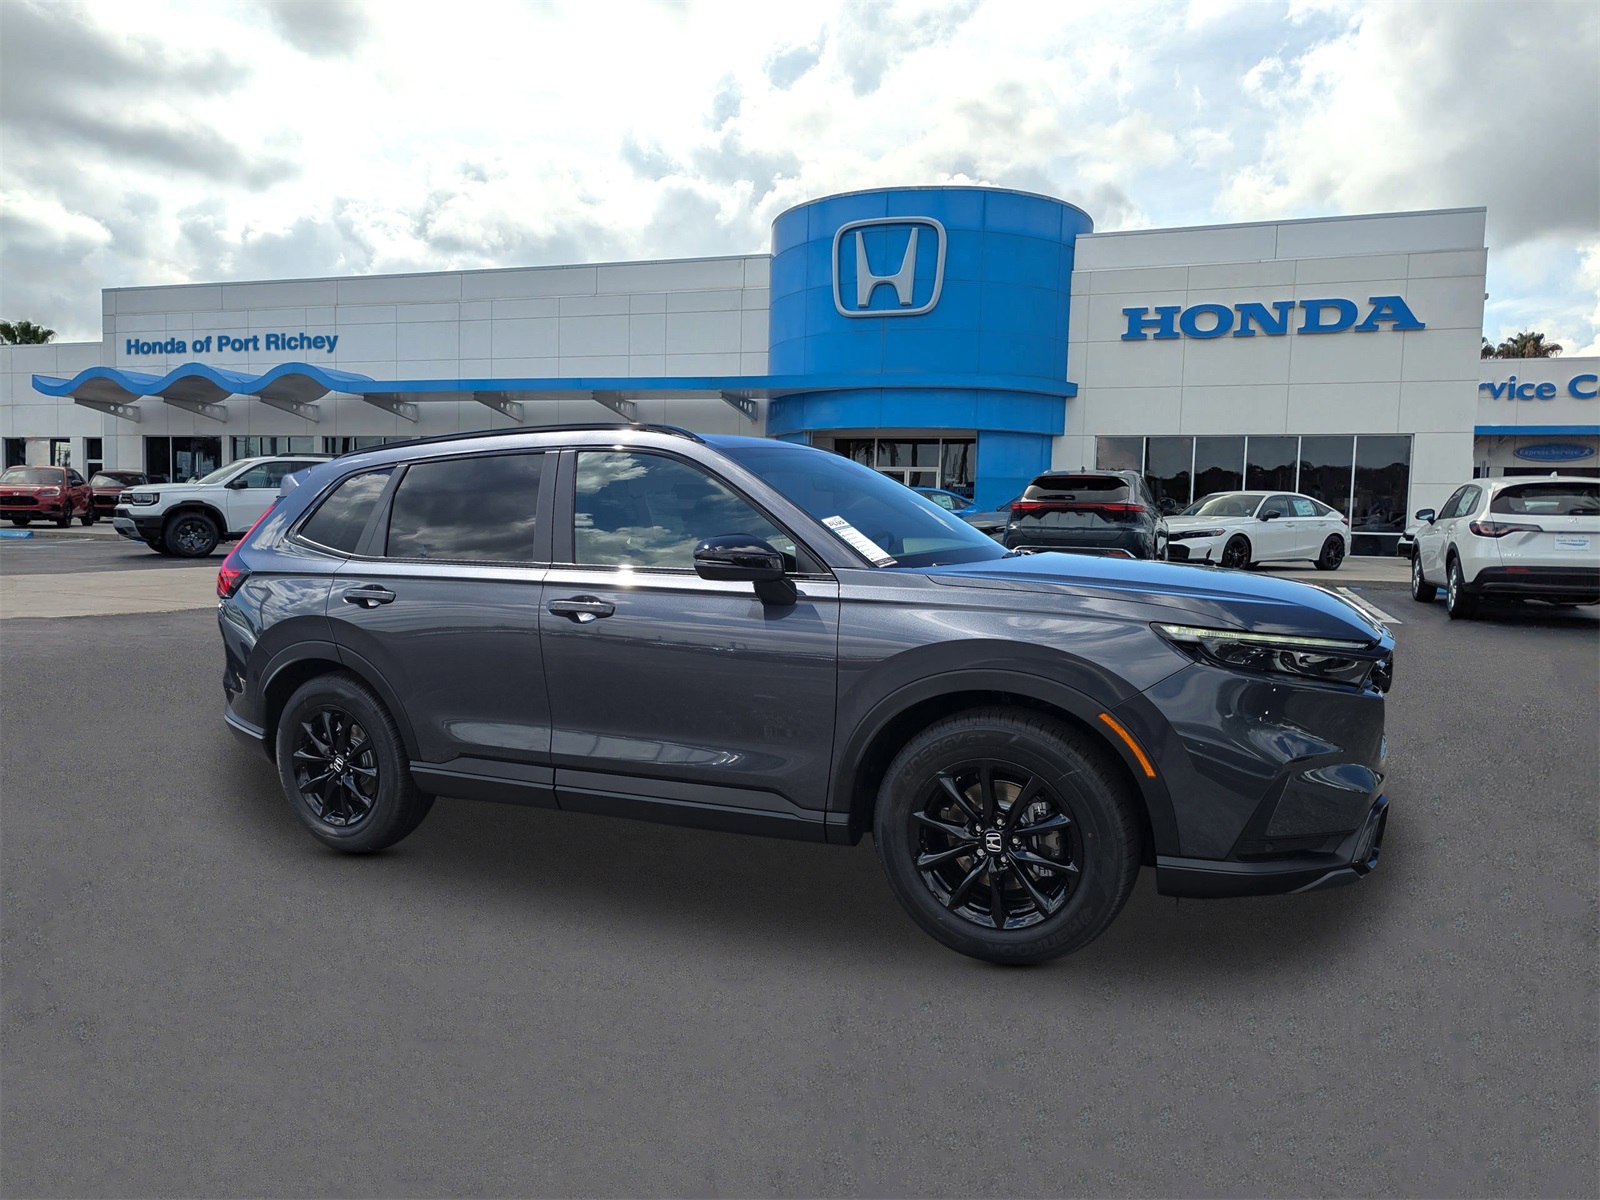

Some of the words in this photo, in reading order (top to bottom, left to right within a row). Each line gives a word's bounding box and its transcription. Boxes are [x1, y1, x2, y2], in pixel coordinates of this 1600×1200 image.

[1121, 295, 1425, 340] HONDA
[126, 337, 187, 355] Honda
[192, 336, 212, 353] of
[217, 335, 259, 352] Port
[265, 332, 339, 353] Richey
[1568, 374, 1600, 400] C
